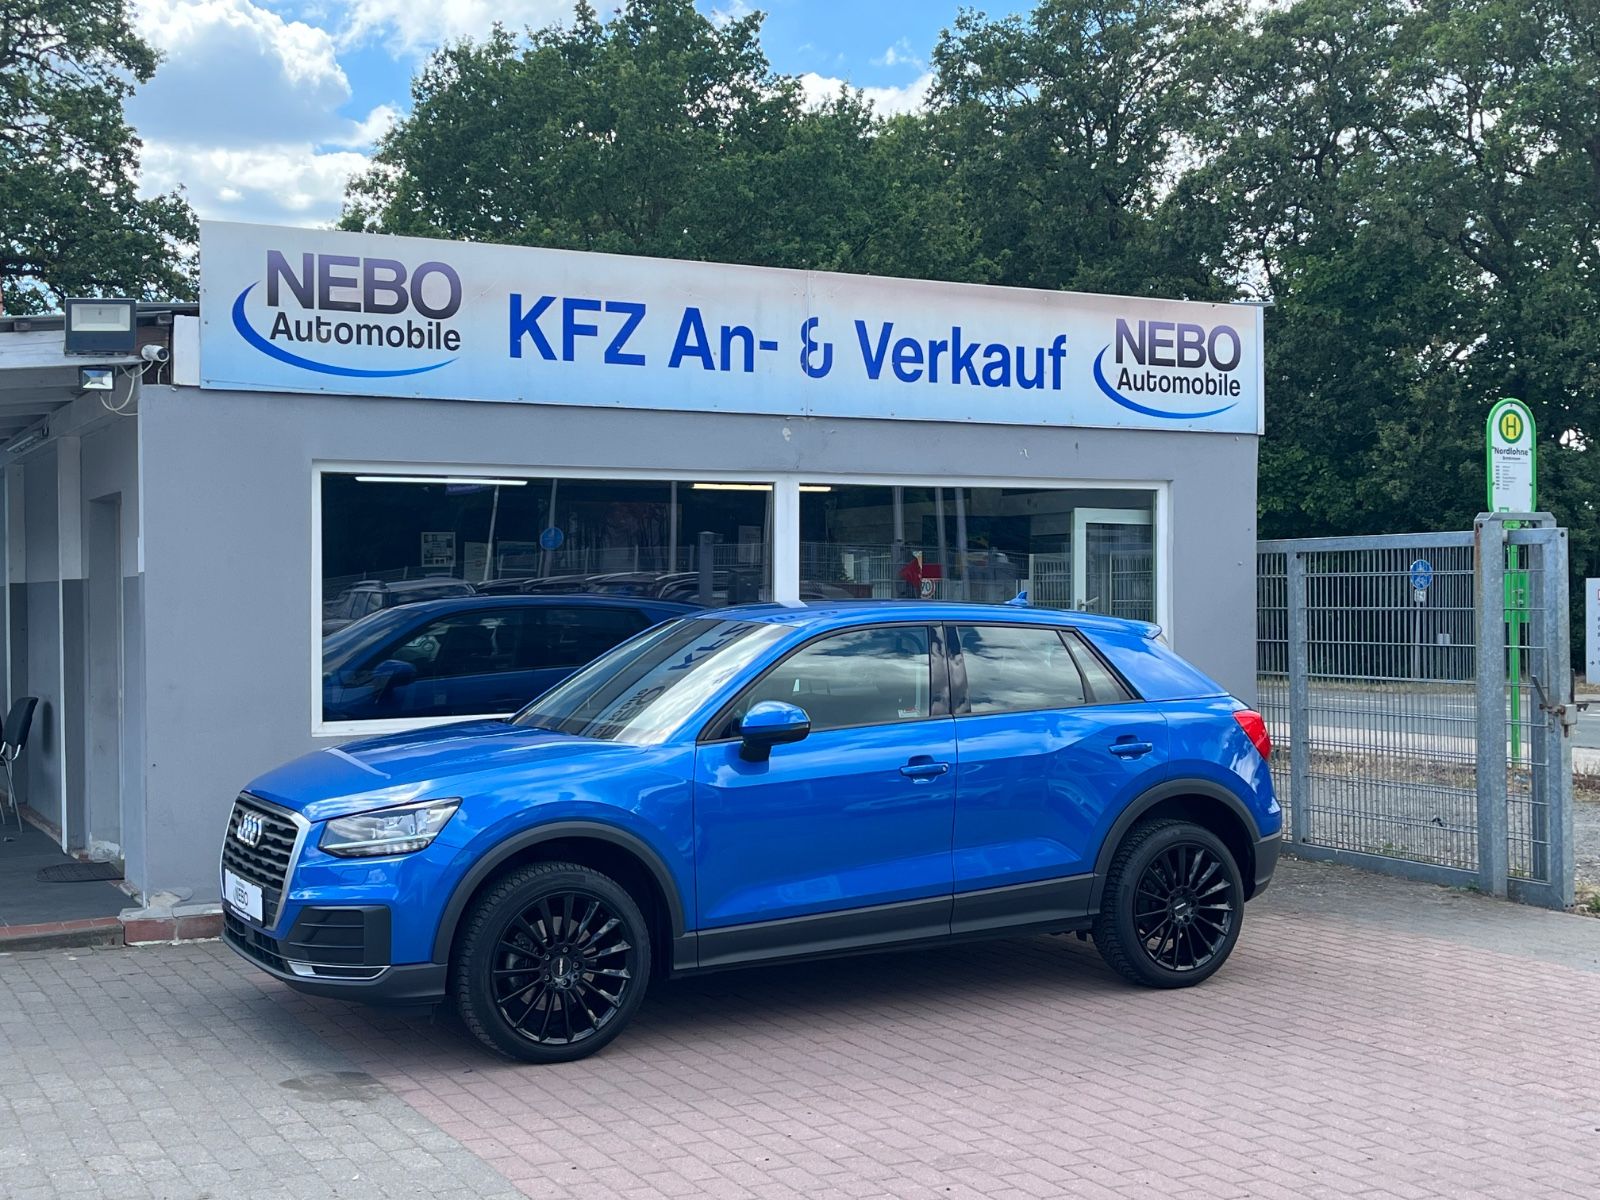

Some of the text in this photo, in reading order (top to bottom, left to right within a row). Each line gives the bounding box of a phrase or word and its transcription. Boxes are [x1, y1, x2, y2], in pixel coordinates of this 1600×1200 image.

[267, 250, 462, 320] NEBO
[269, 311, 461, 352] Automobile
[509, 293, 1067, 390] KFZ An- & Verkauf
[1115, 318, 1241, 372] NEBO
[1116, 367, 1241, 397] Automobile
[1506, 417, 1516, 436] H
[1495, 447, 1528, 456] Nordlohne
